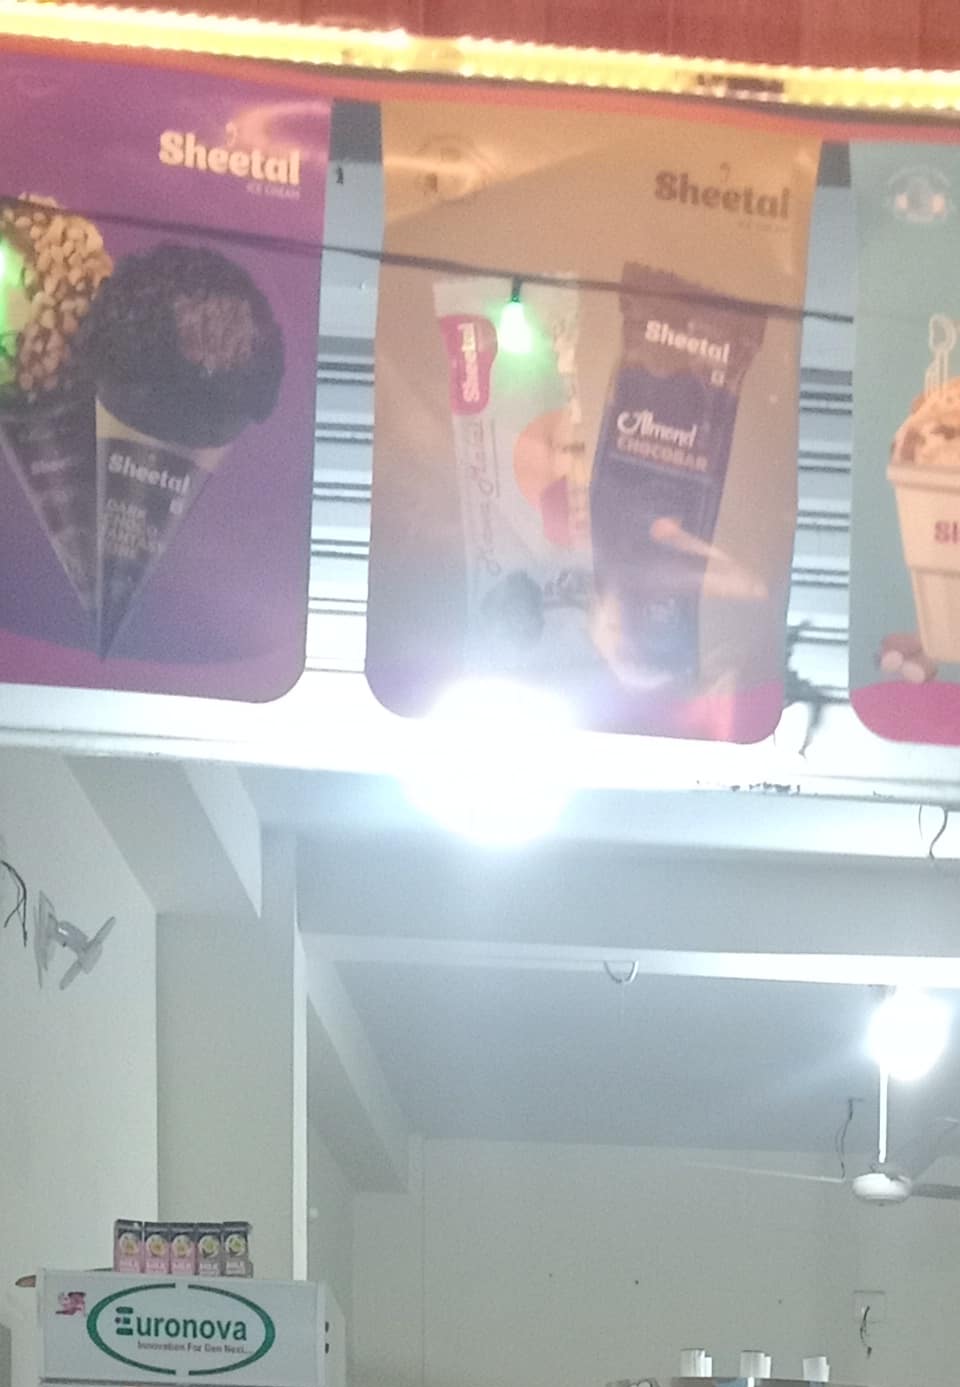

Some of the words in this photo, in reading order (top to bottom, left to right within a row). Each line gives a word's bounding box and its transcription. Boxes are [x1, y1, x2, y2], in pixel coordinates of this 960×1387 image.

[159, 130, 300, 185] Sheetal
[654, 170, 791, 220] Sheetal
[645, 320, 731, 364] Sheetal
[617, 409, 698, 449] Almond
[107, 453, 190, 494] Sheetal
[115, 1306, 247, 1341] Euronova
